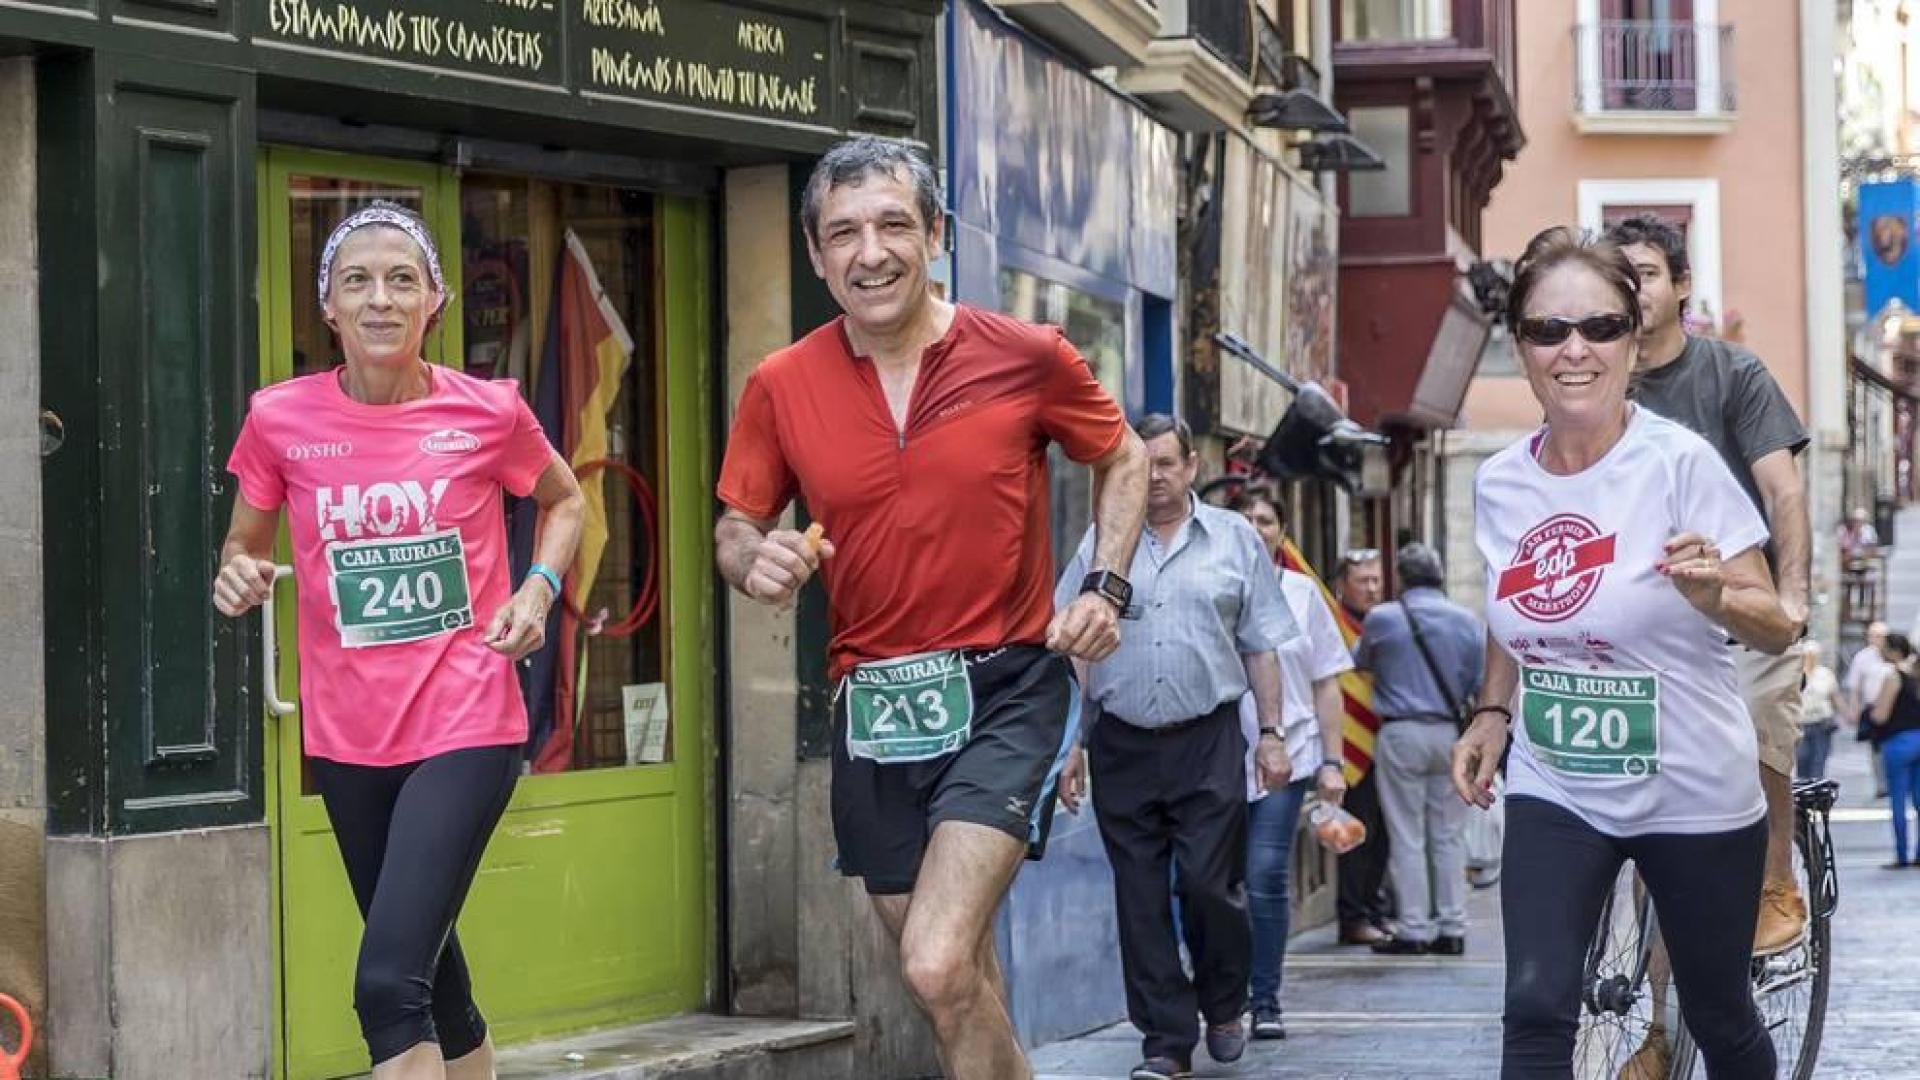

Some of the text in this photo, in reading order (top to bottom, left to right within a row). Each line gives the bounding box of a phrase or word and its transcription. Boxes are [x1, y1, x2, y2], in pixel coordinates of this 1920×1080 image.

[270, 0, 543, 70] ESTAMPAMOS TUS CAMISETAS
[591, 47, 671, 94] PONEMOS
[674, 60, 686, 96] A
[687, 63, 735, 104] PUNTO
[737, 71, 756, 107] TU
[286, 441, 352, 460] OYSHO
[315, 478, 449, 541] HOY
[341, 540, 453, 567] CAJA RURAL
[1535, 548, 1576, 579] edp
[359, 571, 443, 617] 240
[1530, 671, 1647, 698] CAJA RURAL
[871, 688, 949, 732] 213
[1545, 703, 1629, 750] 120
